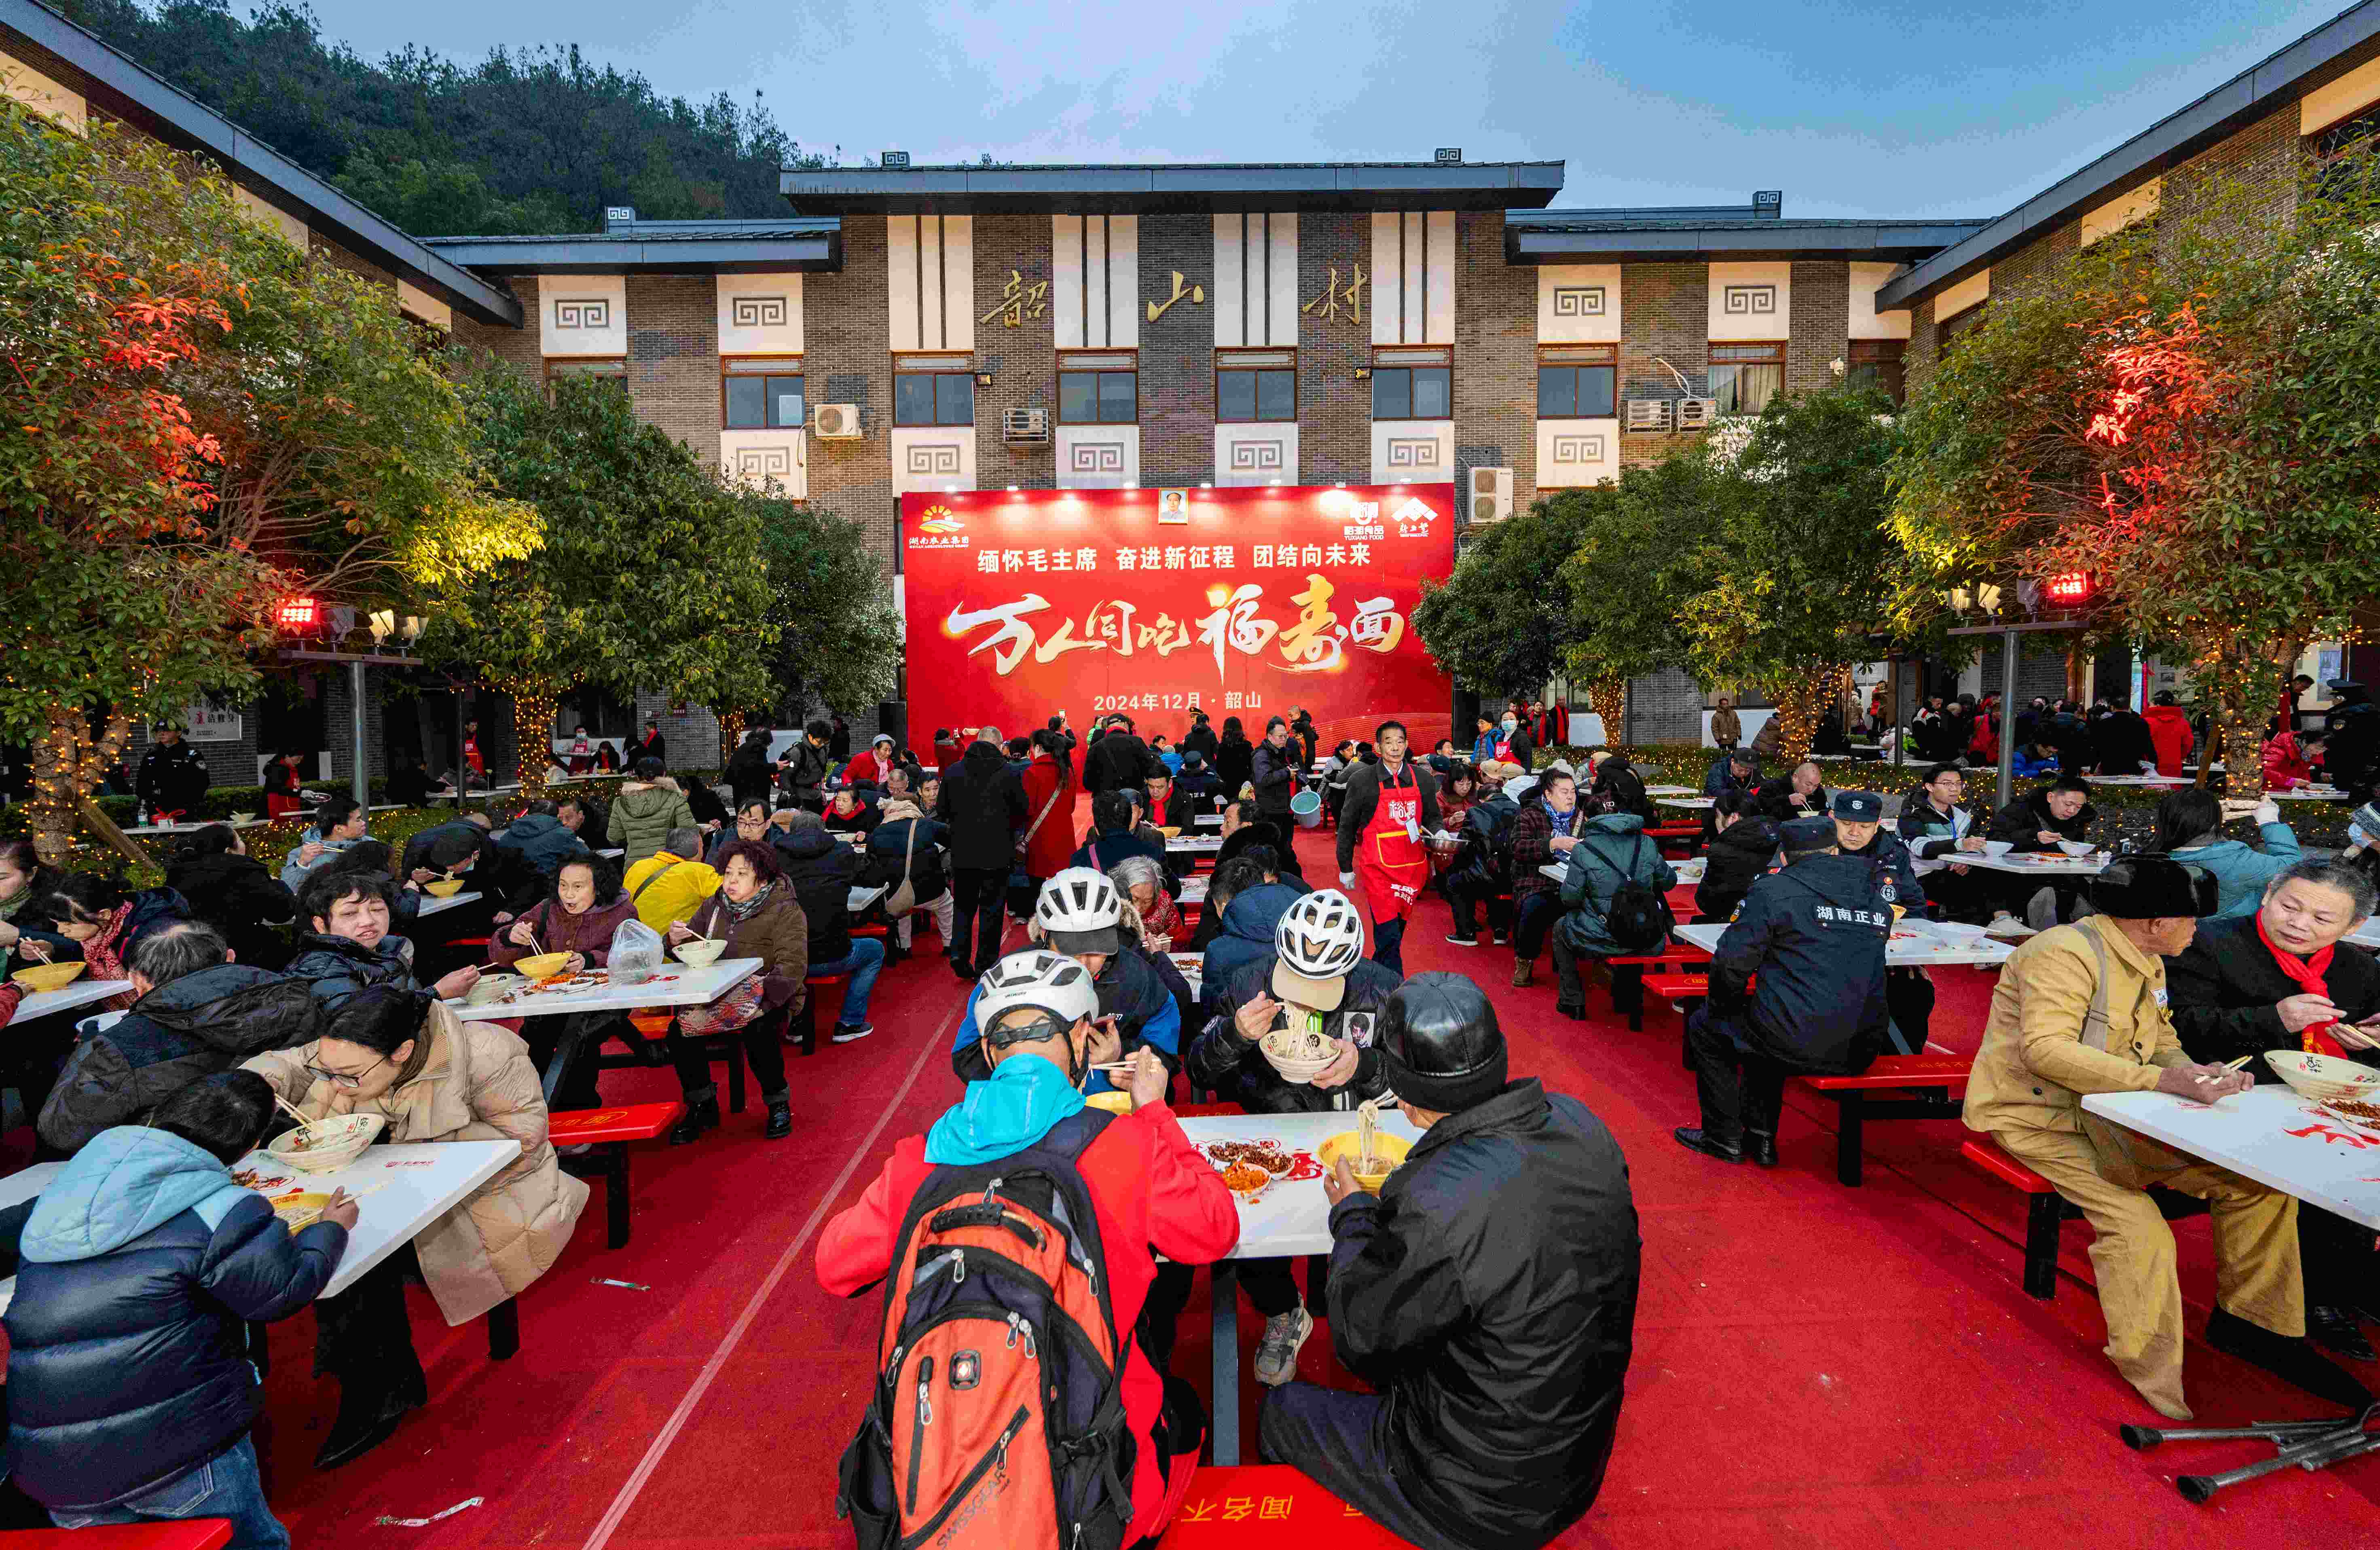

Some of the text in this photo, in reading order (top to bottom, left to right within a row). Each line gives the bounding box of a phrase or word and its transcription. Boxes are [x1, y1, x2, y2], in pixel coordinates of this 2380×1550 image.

[979, 264, 1368, 328] 韶山村
[978, 542, 1371, 573] 缅怀毛主席 奋进新征程 团结向未来
[1816, 906, 1886, 927] 湖南正业
